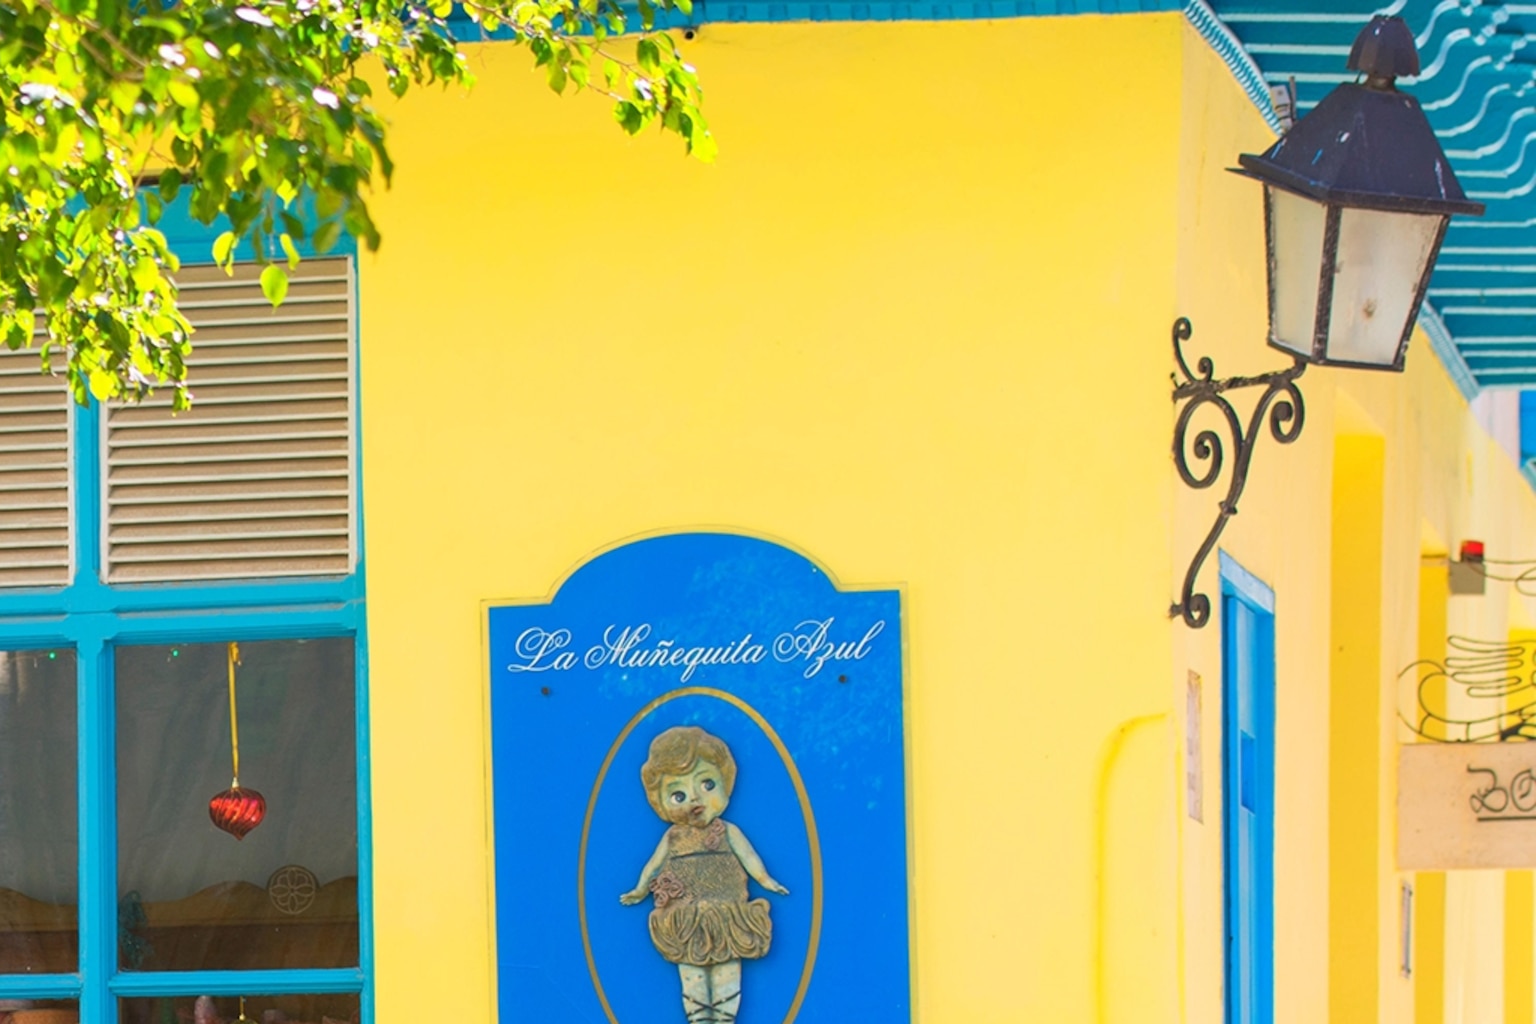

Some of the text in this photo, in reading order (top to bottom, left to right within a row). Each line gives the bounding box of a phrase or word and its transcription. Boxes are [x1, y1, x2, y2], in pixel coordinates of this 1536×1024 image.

[507, 616, 886, 683] La Muñequita Azul
